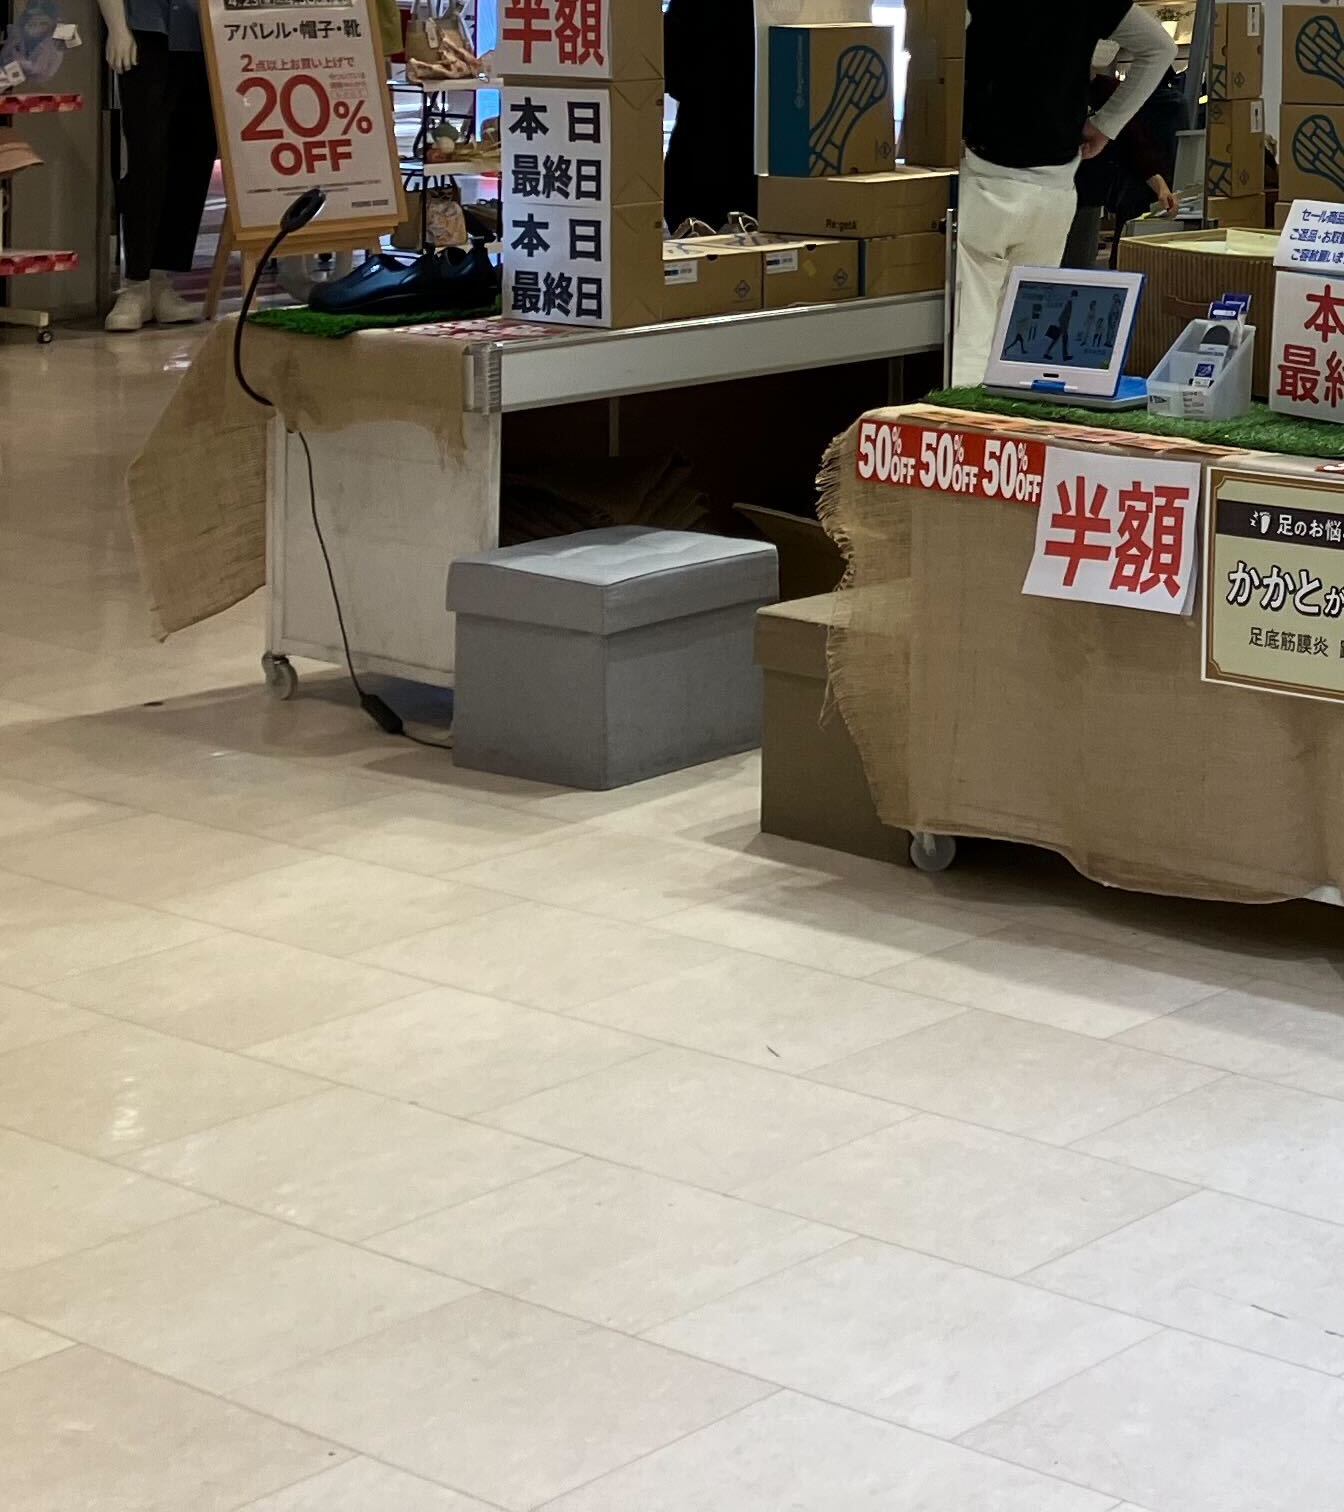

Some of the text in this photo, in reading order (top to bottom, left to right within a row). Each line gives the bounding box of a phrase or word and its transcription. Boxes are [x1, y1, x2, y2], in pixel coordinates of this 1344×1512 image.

[224, 19, 362, 41] アパレル・帽子・靴
[236, 74, 372, 141] 20%
[510, 98, 601, 143] 本日
[271, 139, 353, 175] OFF
[512, 155, 602, 201] 最終日
[511, 215, 602, 261] 本日
[512, 271, 603, 319] 最終日
[891, 454, 914, 484] OFF
[1043, 475, 1190, 597] 半額
[1249, 627, 1329, 657] 足底筋膜炎
